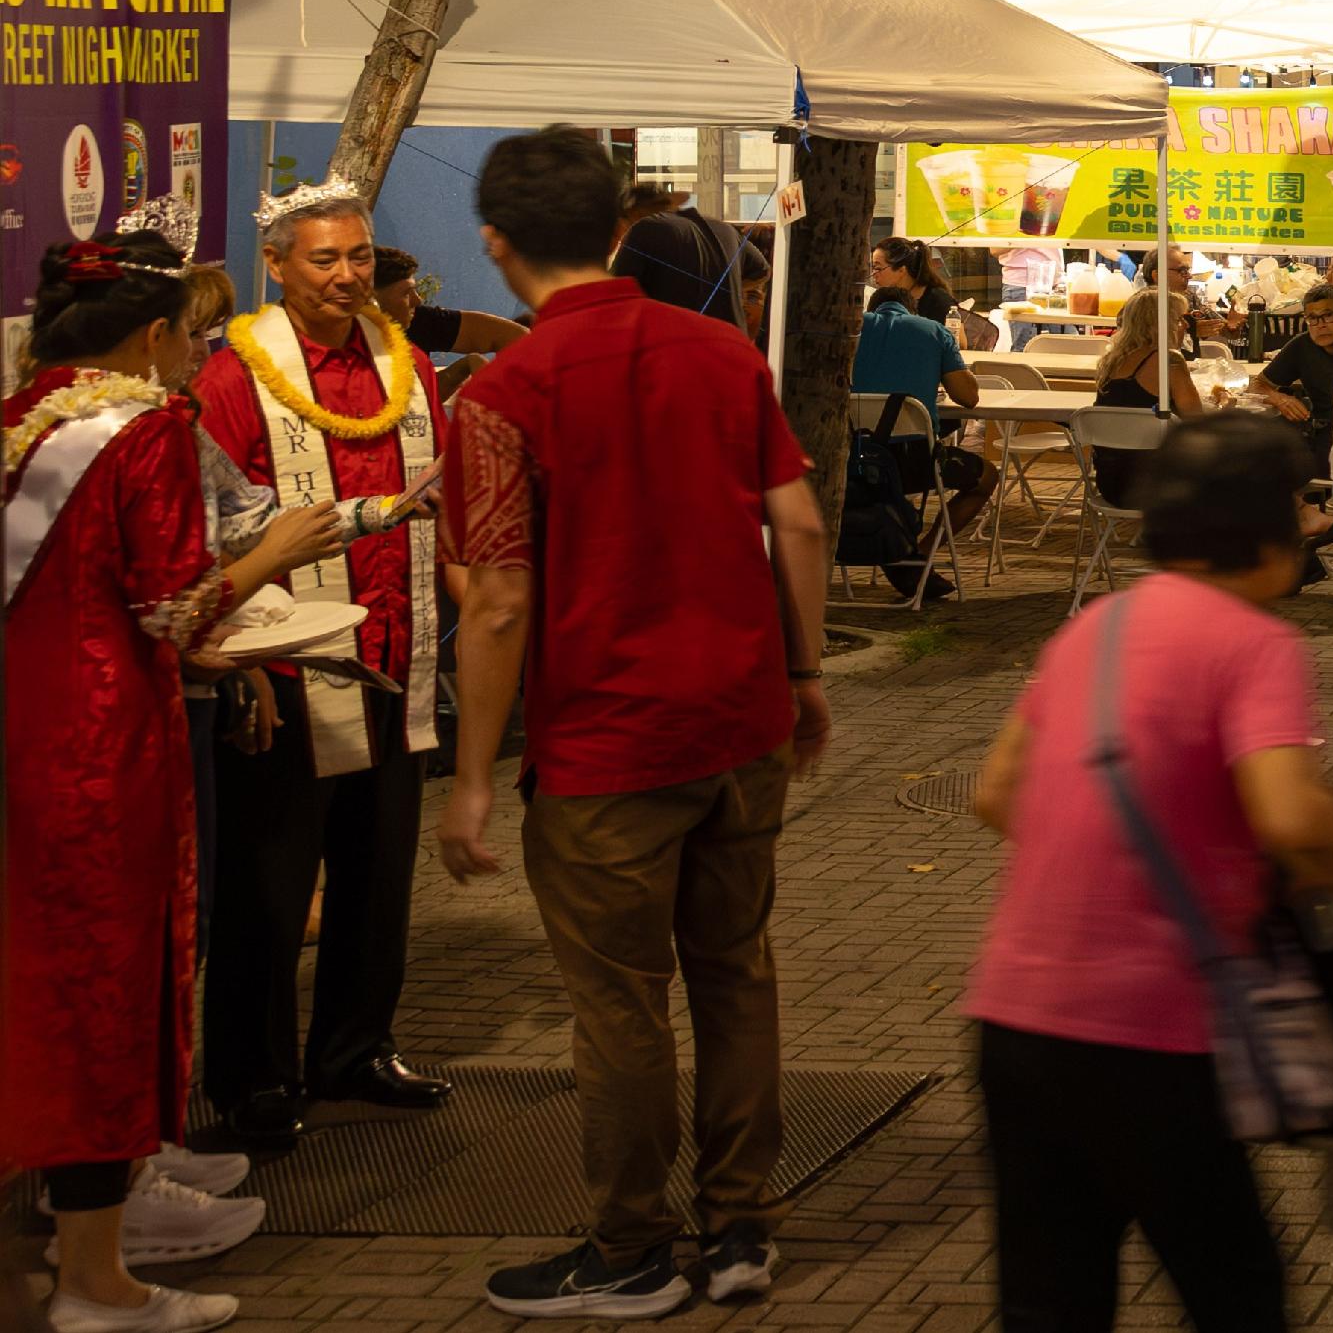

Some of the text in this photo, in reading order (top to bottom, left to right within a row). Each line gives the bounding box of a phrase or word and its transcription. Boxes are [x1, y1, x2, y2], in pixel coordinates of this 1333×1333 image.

[62, 25, 126, 85] NIGH
[1108, 167, 1305, 204] 果茶莊園
[1207, 206, 1304, 223] NATURE
